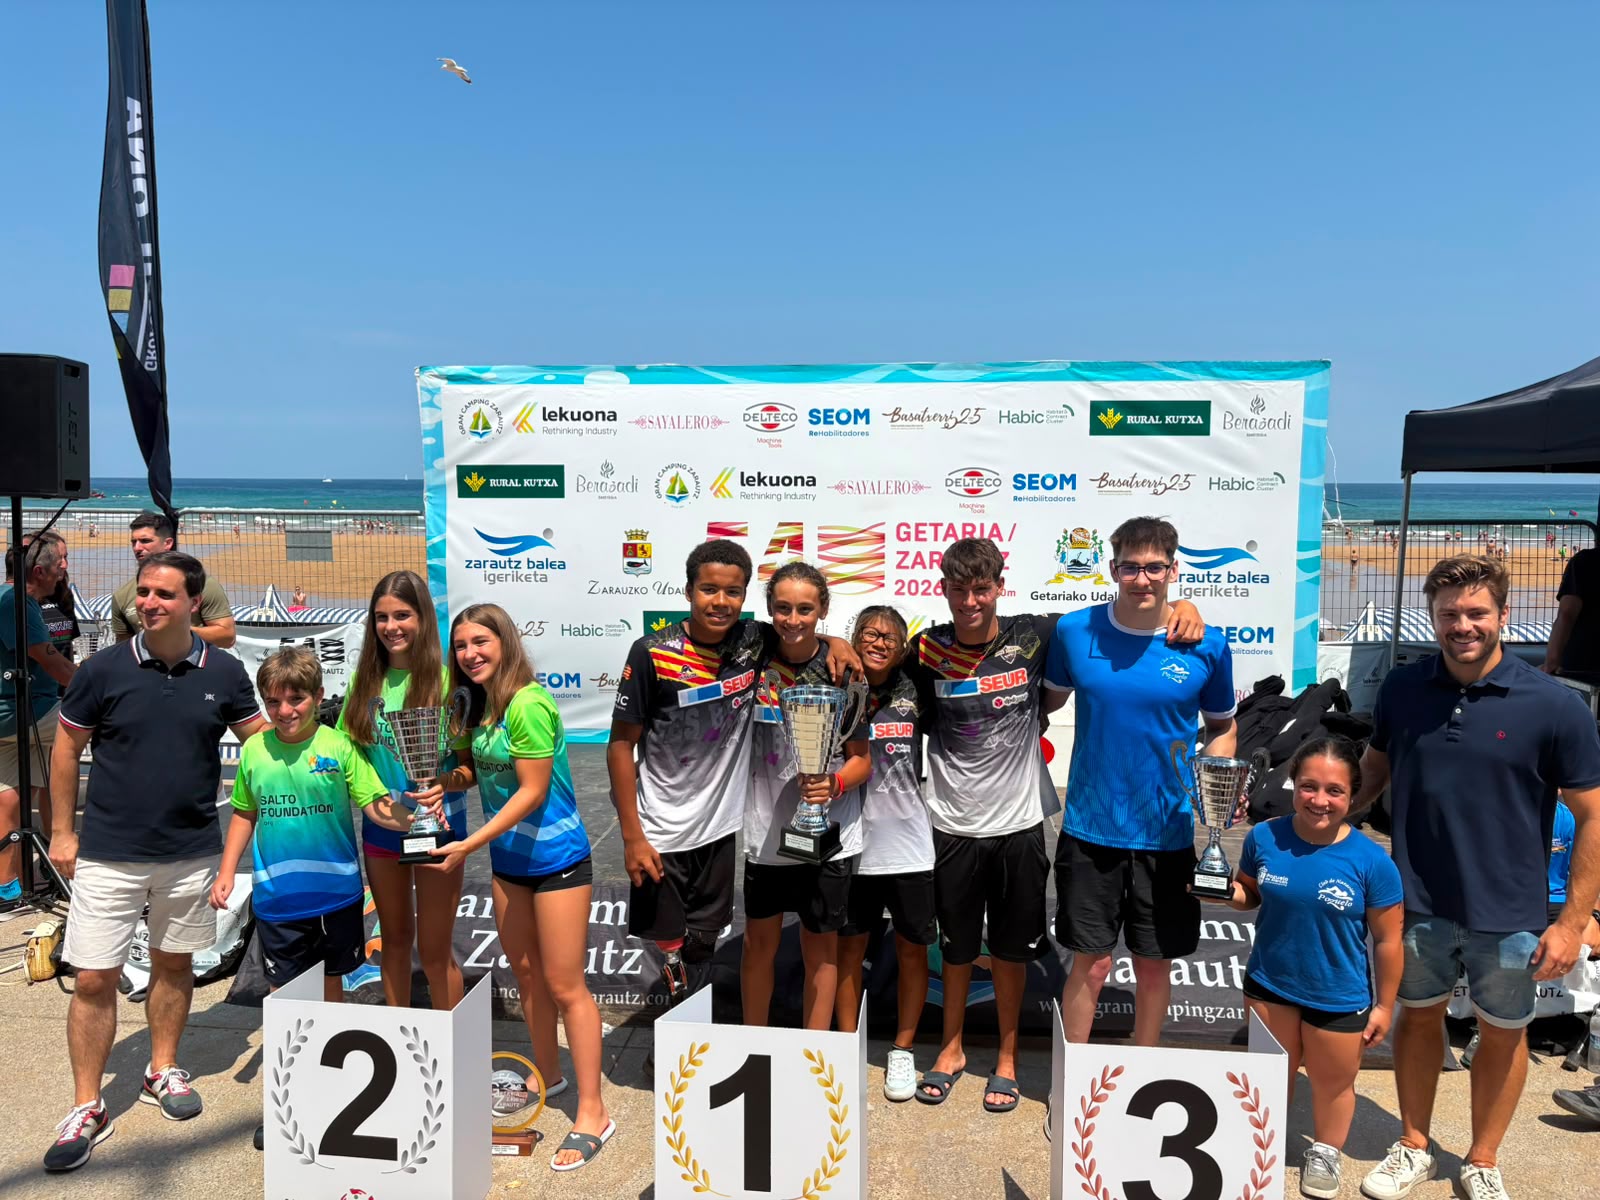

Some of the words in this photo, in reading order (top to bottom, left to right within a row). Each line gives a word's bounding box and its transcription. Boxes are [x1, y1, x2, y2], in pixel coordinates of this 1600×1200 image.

[461, 398, 490, 414] CAMPING
[490, 403, 503, 434] ZARAUTZ
[542, 406, 617, 422] lekuona
[743, 413, 798, 422] DELTECO
[808, 408, 870, 425] SEOM
[999, 410, 1044, 424] Habic
[1127, 415, 1162, 424] RURAL
[1165, 415, 1203, 424] KUTXA
[647, 415, 710, 430] SAYALERO
[542, 427, 583, 437] Rethinking
[585, 427, 618, 437] Industry
[489, 478, 521, 487] RURAL
[523, 478, 558, 487] KUTXA
[654, 478, 662, 499] GRAN
[658, 463, 687, 478] CAMPING
[687, 467, 700, 499] ZARAUTZ
[740, 471, 816, 487] lekuona
[945, 478, 1002, 487] DELTECO
[1012, 473, 1076, 491] SEOM
[1209, 477, 1255, 491] Habic
[847, 480, 911, 495] SAYALERO
[740, 492, 782, 501] Rethinking
[784, 492, 817, 501] Industry
[465, 557, 522, 569] zarautz
[527, 558, 566, 569] balea
[483, 570, 548, 585] igeriketa
[1177, 572, 1221, 584] rautz
[1227, 571, 1270, 584] balea
[652, 581, 686, 595] UDAL
[894, 579, 945, 596] 2026
[1179, 584, 1250, 599] igeriketa
[1030, 591, 1087, 601] Getariako
[1091, 591, 1119, 601] Udal
[561, 624, 604, 637] Habic
[1231, 648, 1273, 656] bilitadores
[536, 673, 581, 688] EOM
[980, 668, 1027, 693] SEUR
[875, 722, 913, 739] SEUR
[260, 794, 296, 805] SALTO
[261, 803, 334, 818] FOUNDATION
[1317, 893, 1353, 911] Pozuelo
[318, 1029, 399, 1162] 2
[709, 1054, 772, 1193] 1
[1122, 1079, 1223, 1200] 3
